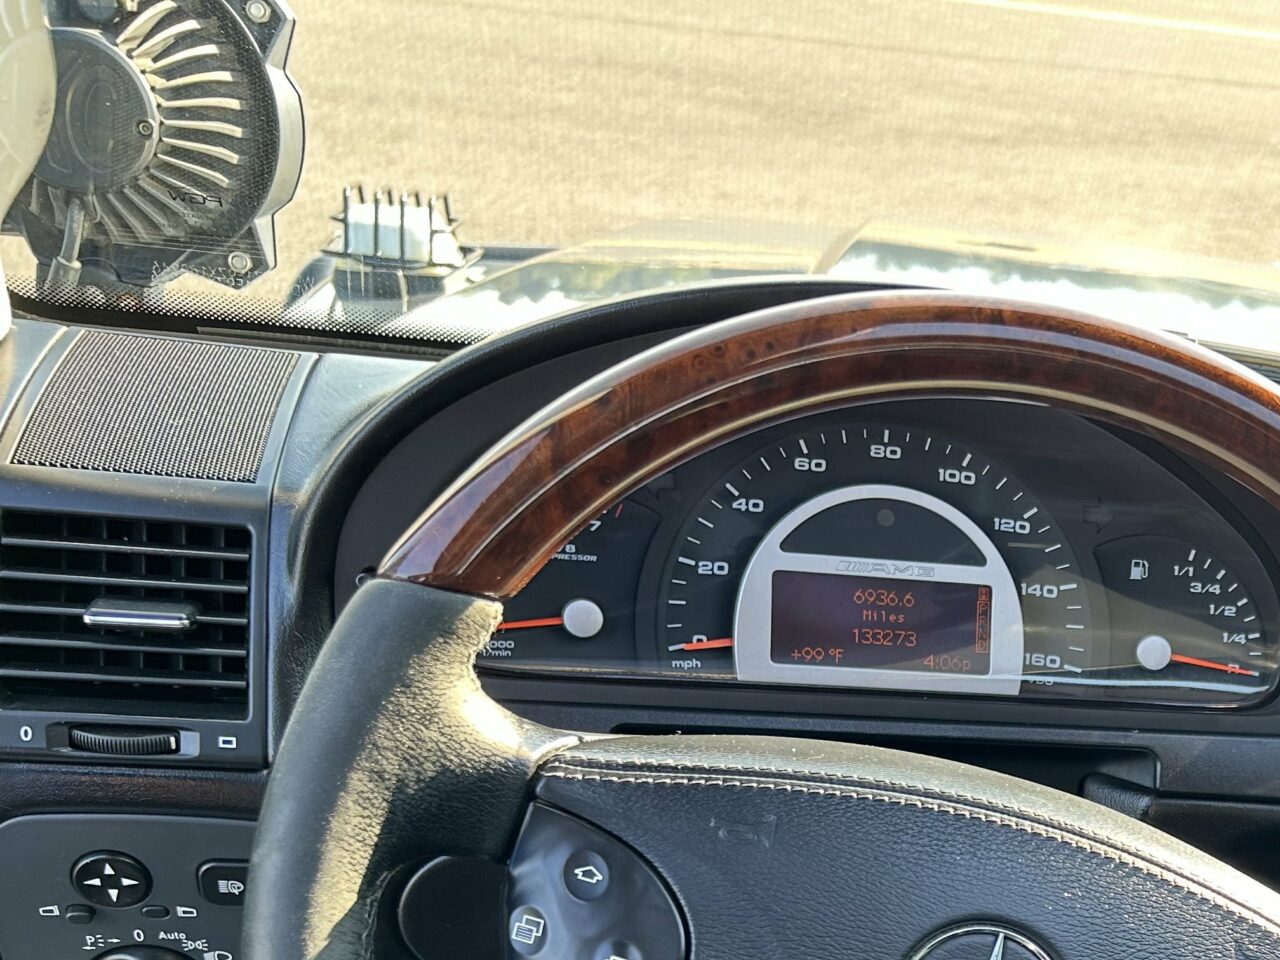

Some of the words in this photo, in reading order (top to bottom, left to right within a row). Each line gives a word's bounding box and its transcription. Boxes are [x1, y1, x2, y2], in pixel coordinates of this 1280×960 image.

[870, 445, 901, 459] 80
[794, 457, 826, 472] 60
[938, 468, 976, 485] 100
[732, 498, 764, 512] 40
[589, 520, 601, 532] 7
[993, 517, 1031, 534] 120
[698, 561, 729, 575] 20
[1173, 565, 1194, 577] 1/1
[1020, 583, 1058, 598] 140
[1190, 582, 1221, 594] 3/4
[853, 588, 915, 607] 6936.6
[862, 609, 905, 623] Miles
[1209, 604, 1236, 617] 1/2
[852, 628, 917, 647] 133273
[1222, 632, 1247, 644] 1/4
[672, 658, 701, 670] mph
[923, 654, 971, 671] 4:06p
[1025, 653, 1060, 668] 160
[133, 929, 144, 942] 0
[158, 930, 187, 941] Auto
